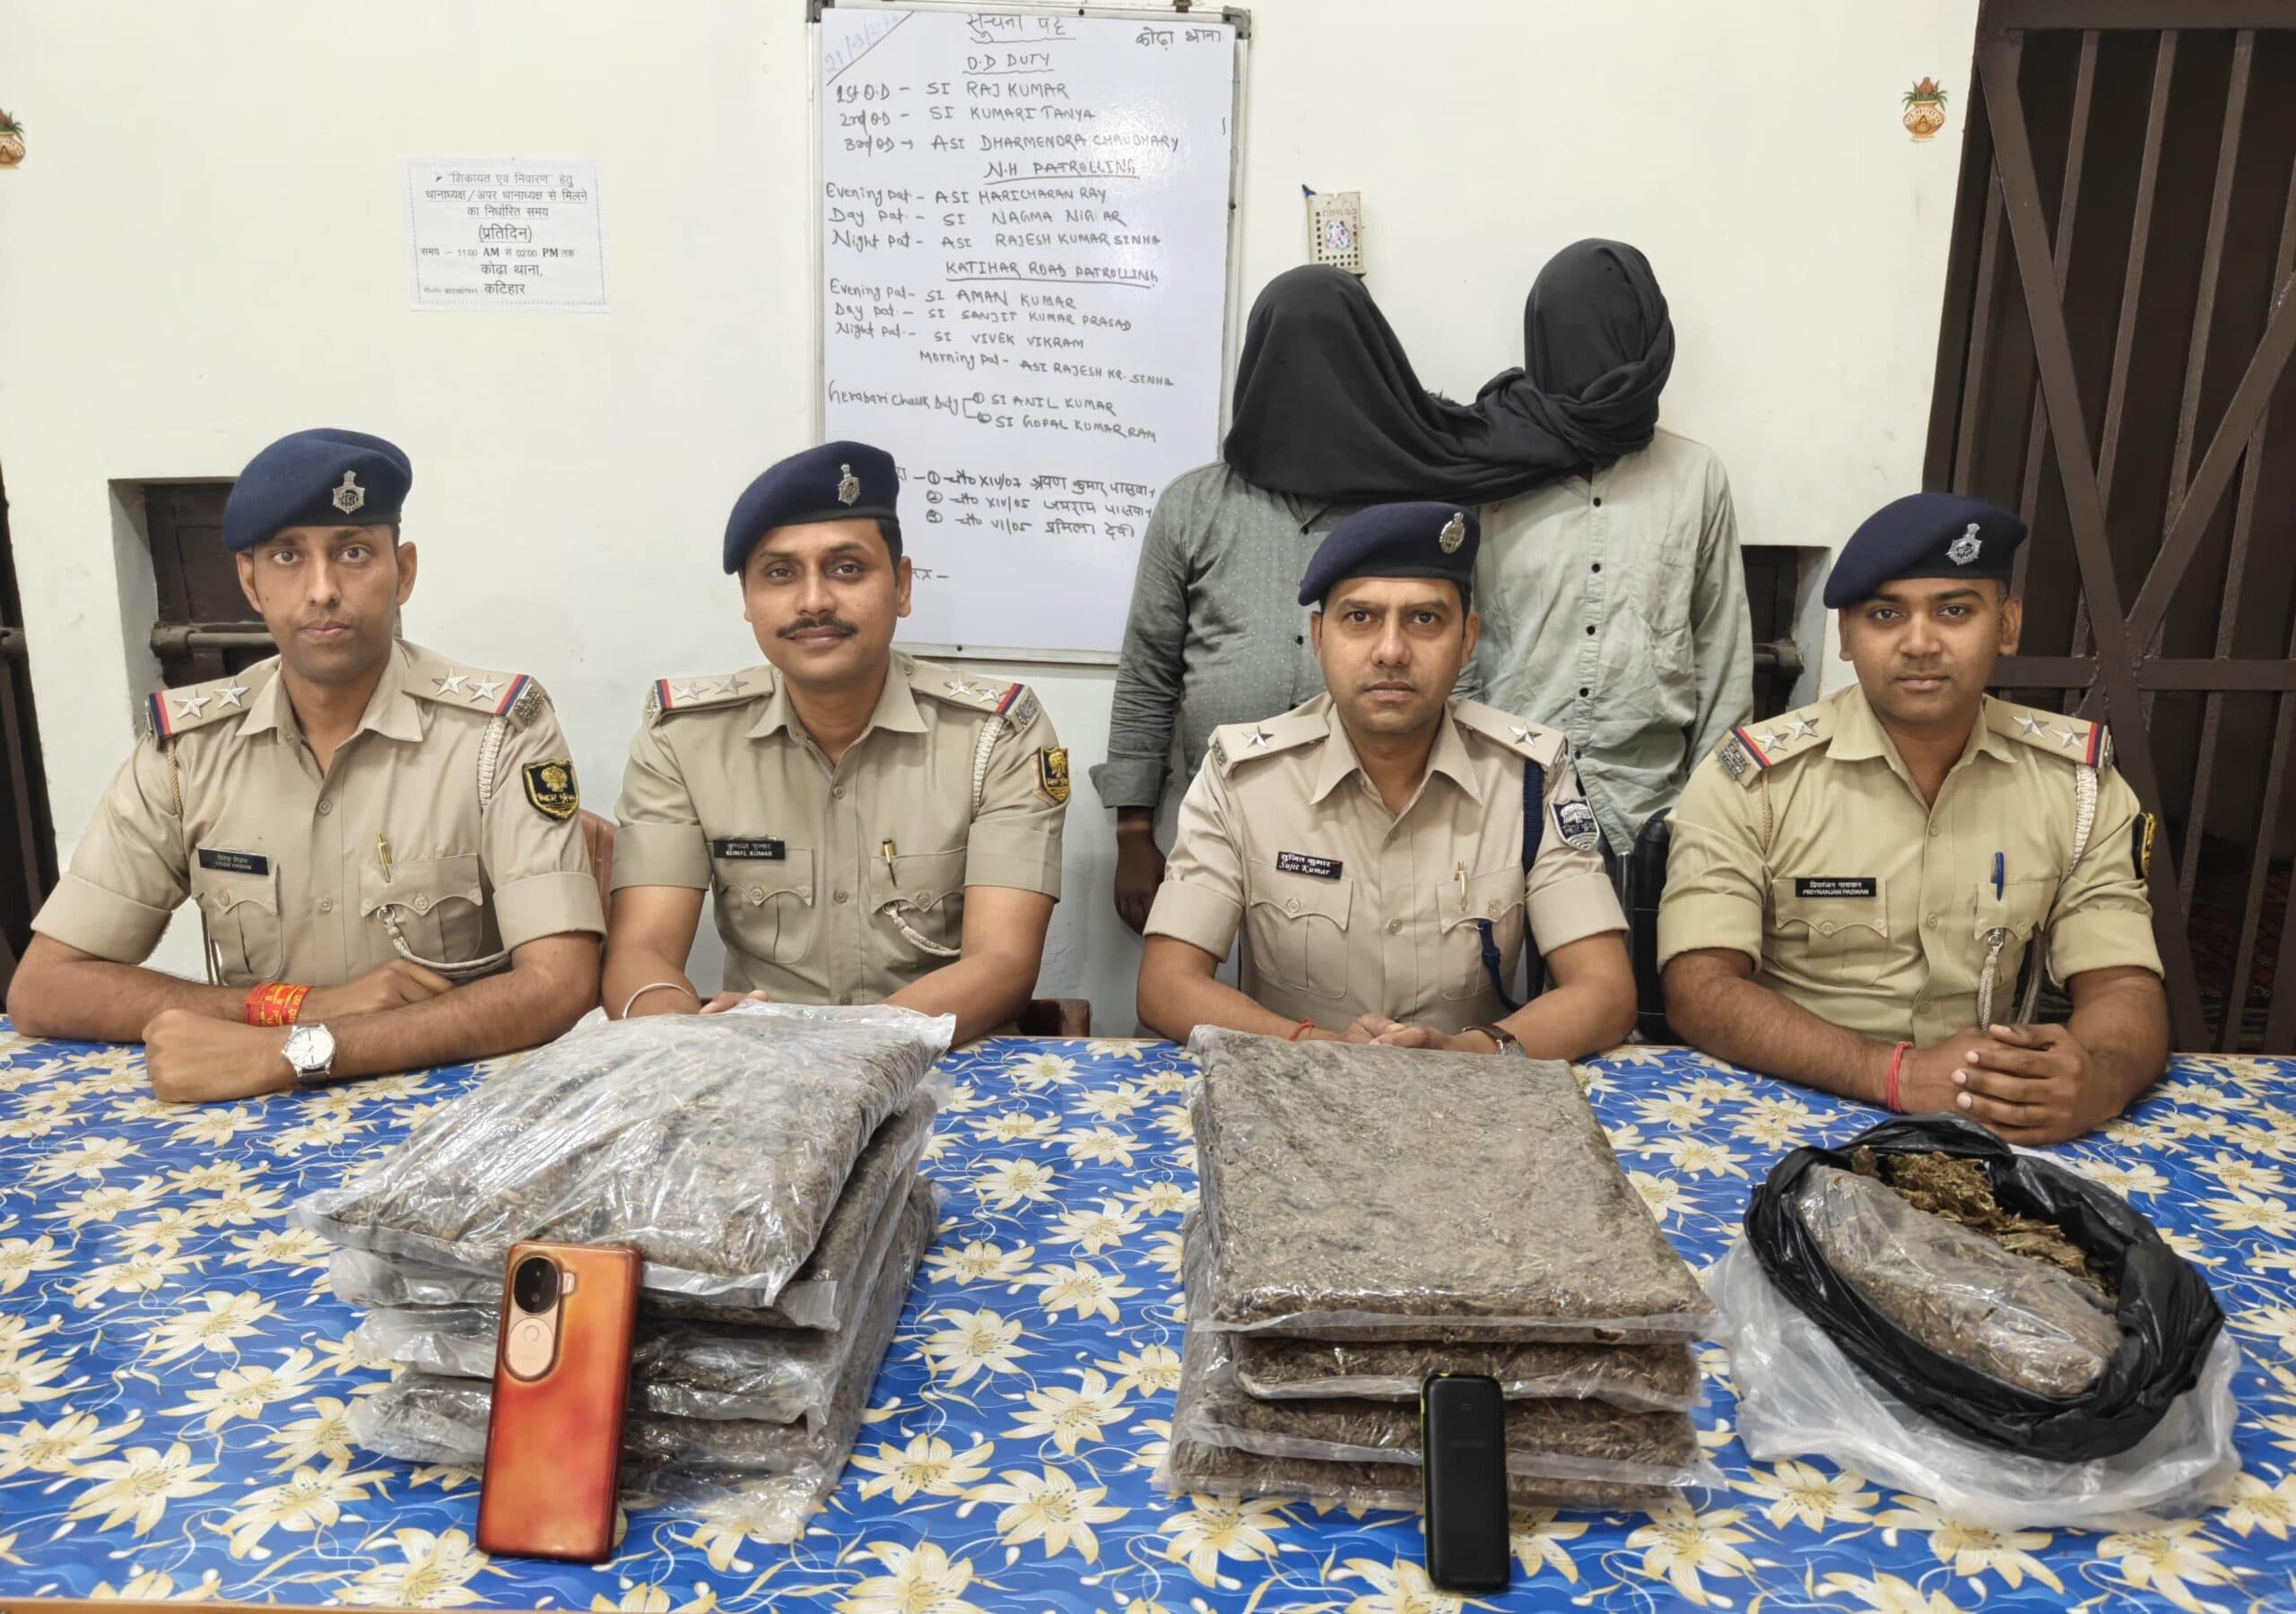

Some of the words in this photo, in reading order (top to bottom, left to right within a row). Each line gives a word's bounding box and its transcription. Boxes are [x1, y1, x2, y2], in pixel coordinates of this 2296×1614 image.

[1007, 54, 1049, 66] DUTY
[926, 82, 951, 95] SI
[966, 80, 1000, 99] RAJ
[1008, 82, 1070, 100] KUMAR
[929, 106, 954, 119] SI
[970, 106, 1036, 122] KUMARI
[1041, 105, 1096, 122] TANYA
[931, 134, 966, 152] ASI
[979, 134, 1087, 152] DHARMENDRA
[1093, 134, 1178, 152] CHAUDHARY
[1033, 159, 1136, 177] PATROLLING
[549, 189, 557, 201] से
[561, 188, 588, 202] मिलने
[826, 182, 883, 207] Evening
[935, 191, 969, 204] ASI
[978, 189, 1074, 205] HARICHARAN
[1079, 187, 1107, 204] RAY
[466, 206, 479, 217] का
[484, 204, 521, 218] निर्धारित
[526, 207, 549, 217] समय
[828, 207, 865, 228] Day
[943, 213, 966, 226] SI
[992, 210, 1053, 225] NAGMA
[478, 223, 533, 243] (प्रतिदिन)
[831, 229, 880, 253] Night
[941, 236, 972, 249] ASI
[996, 232, 1051, 247] RAJESH
[1057, 233, 1111, 247] KUMAR
[1114, 234, 1161, 246] SINHA
[483, 247, 500, 256] AM
[543, 247, 559, 257] PM
[946, 260, 1022, 280] KATIHAR
[1029, 261, 1067, 277] ROAD
[1075, 265, 1159, 283] PATROLLING
[483, 279, 526, 295] कटिहार
[830, 278, 881, 301] Evening
[925, 290, 945, 302] SI
[956, 289, 1009, 306] AMAN
[1021, 293, 1076, 310] KUMAR
[834, 302, 863, 322] Day
[928, 308, 945, 318] SI
[961, 310, 1017, 324] SANJIT
[1029, 312, 1075, 325] KUMAR
[1083, 315, 1132, 332] PRASAD
[835, 322, 874, 340] Night
[935, 331, 952, 343] SI
[971, 332, 1015, 346] VIVEK
[1026, 335, 1084, 349] VIKRAM
[919, 351, 975, 370] Morning
[1019, 360, 1048, 372] ASI
[1054, 362, 1102, 377] RAJESH
[1129, 374, 1174, 386] SINHA
[992, 394, 1006, 405] SI
[1013, 395, 1058, 409] ANIL
[1065, 397, 1117, 416] KUMAR
[996, 415, 1013, 428] SI
[1022, 414, 1068, 430] GOPAL
[1075, 420, 1127, 438] KUMAR
[1127, 427, 1156, 443] RAM
[1279, 861, 1300, 872] Sujit
[1301, 863, 1331, 875] Kumar
